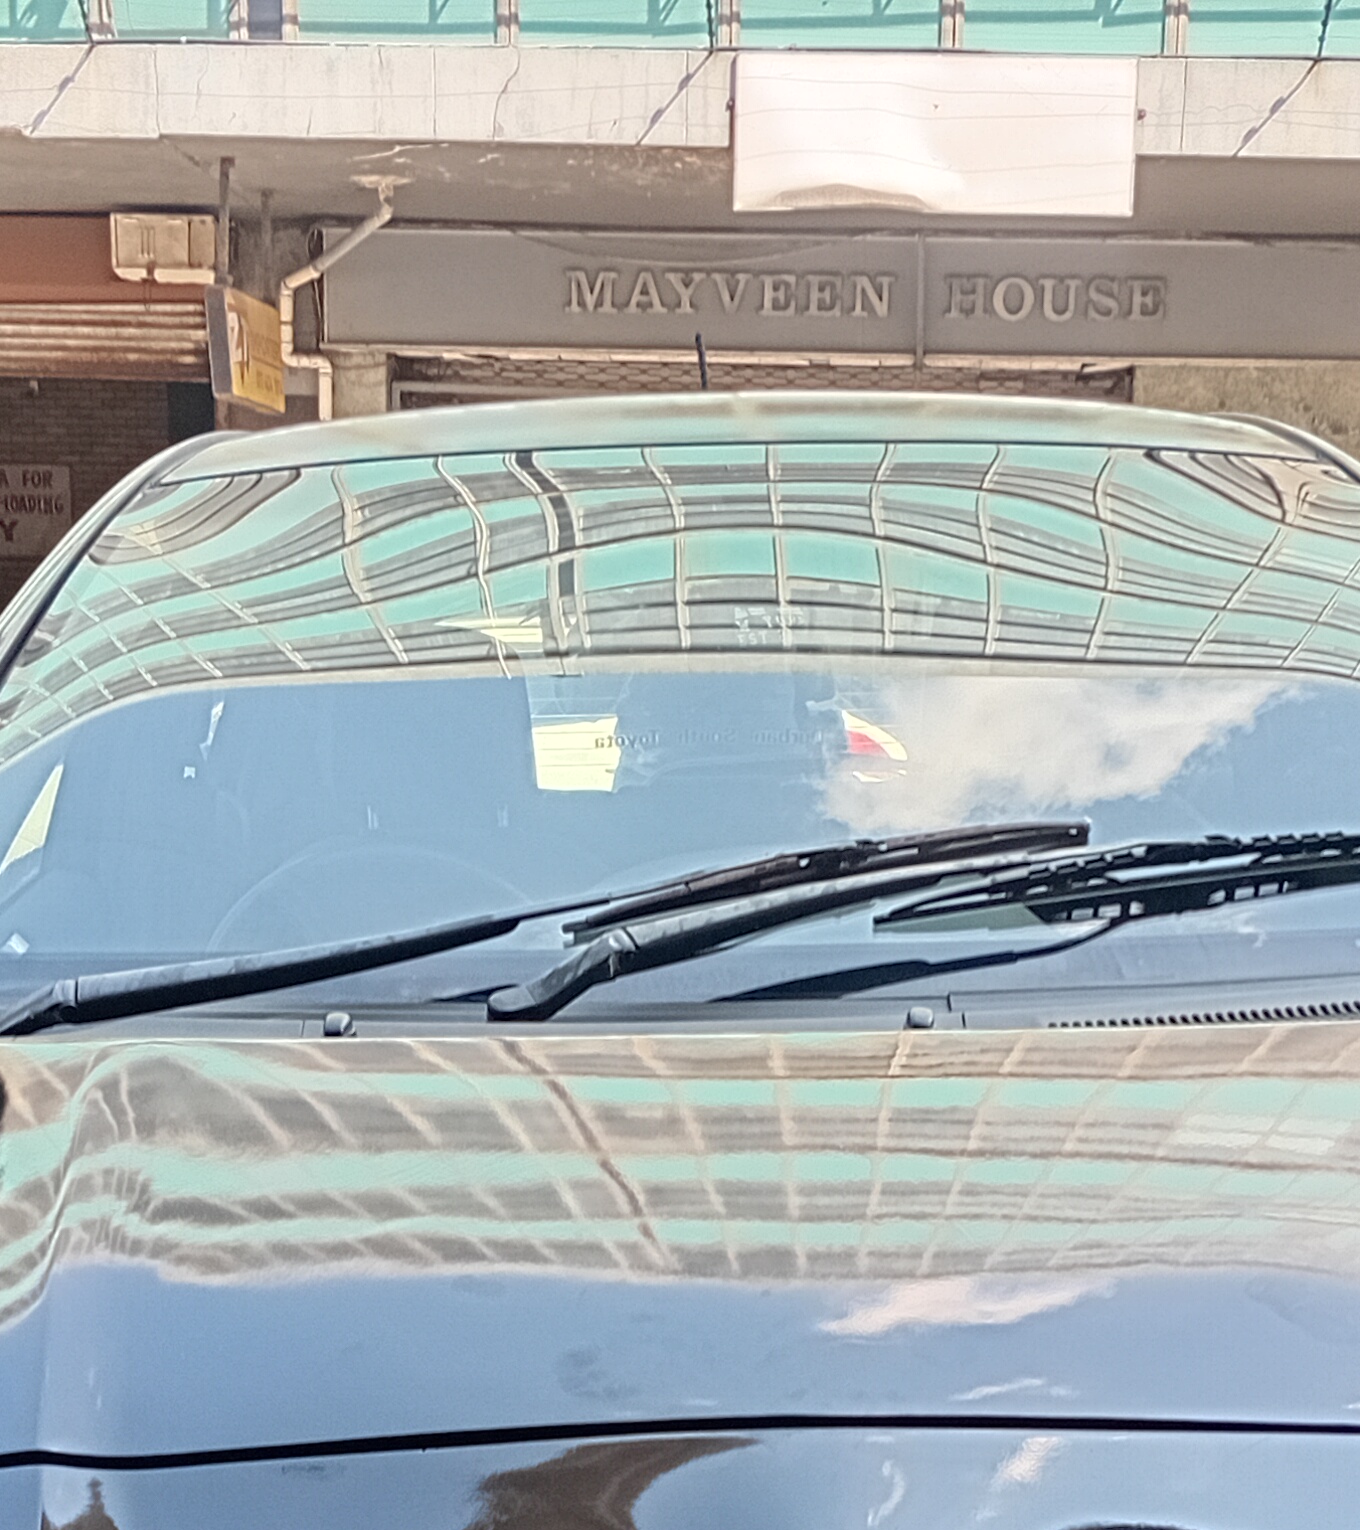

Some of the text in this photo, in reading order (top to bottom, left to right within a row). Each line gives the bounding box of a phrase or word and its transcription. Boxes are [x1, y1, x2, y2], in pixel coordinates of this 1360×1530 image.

[564, 269, 1170, 323] MAYVEEN HOUSE
[21, 469, 54, 489] FOR
